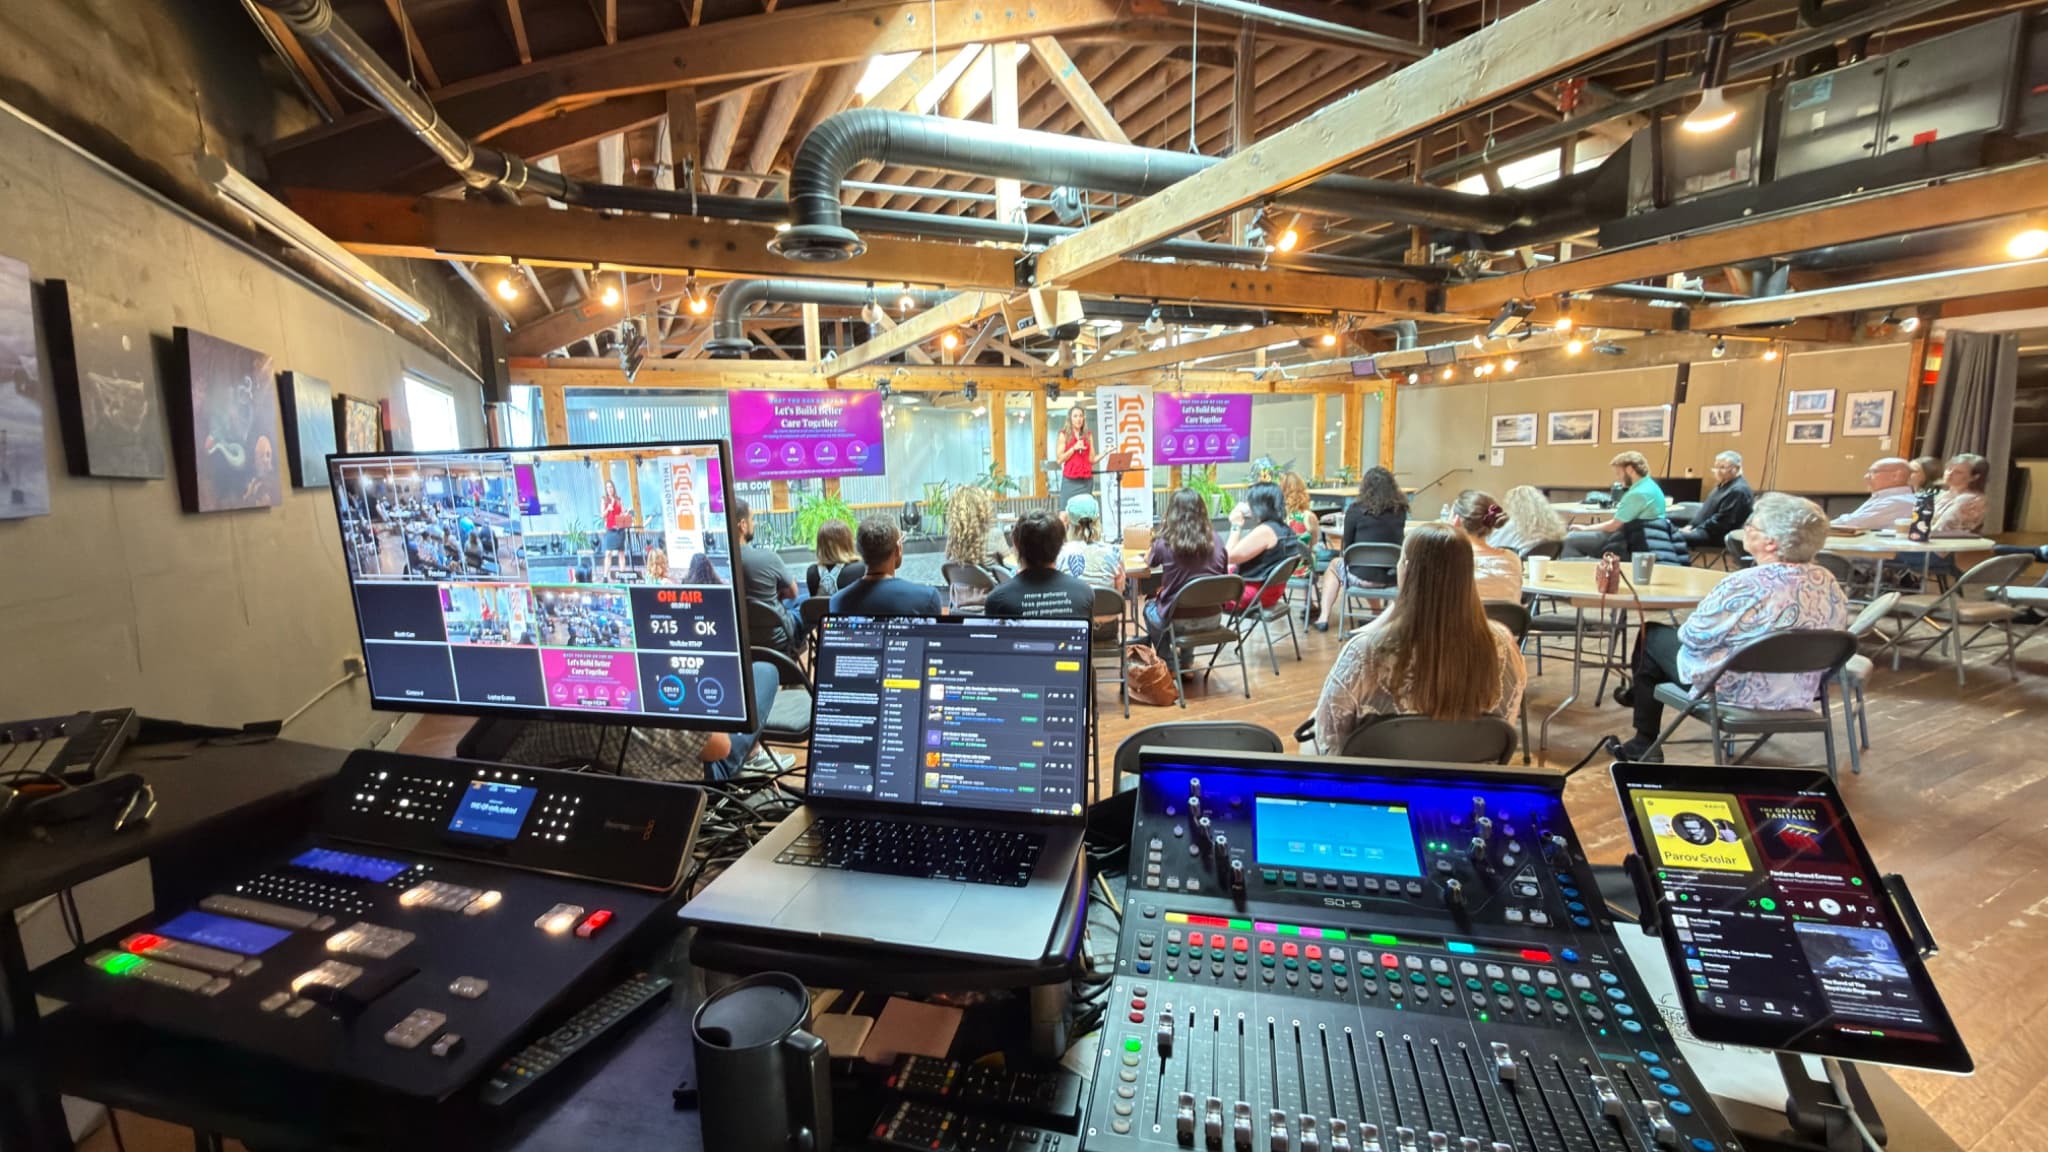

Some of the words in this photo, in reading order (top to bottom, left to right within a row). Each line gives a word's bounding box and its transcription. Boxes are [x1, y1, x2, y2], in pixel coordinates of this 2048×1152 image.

[774, 406, 794, 416] Let's
[795, 406, 817, 416] Build
[818, 405, 843, 416] Better
[1182, 406, 1195, 414] Let's
[1196, 406, 1210, 414] Build
[1211, 406, 1226, 414] Better
[781, 418, 801, 428] Care
[802, 418, 838, 429] Together
[1103, 400, 1114, 448] MILLIO
[1185, 416, 1199, 424] Care
[1200, 416, 1222, 424] Together
[657, 590, 677, 602] ON
[680, 590, 703, 603] AIR
[1021, 600, 1035, 608] less
[1036, 598, 1072, 608] passwords
[1039, 608, 1073, 617] payments
[651, 620, 679, 634] 9.15
[695, 621, 717, 636] OK
[567, 658, 580, 667] Let's
[580, 659, 594, 667] Build
[594, 660, 611, 669] Better
[670, 656, 705, 669] STOP
[571, 667, 585, 676] Care
[585, 668, 608, 678] Together
[1765, 812, 1816, 822] FANFARES
[1775, 807, 1817, 816] GREATEST
[1664, 850, 1699, 863] Parov
[1700, 854, 1738, 865] Stolar
[1323, 897, 1362, 909] SQ-5
